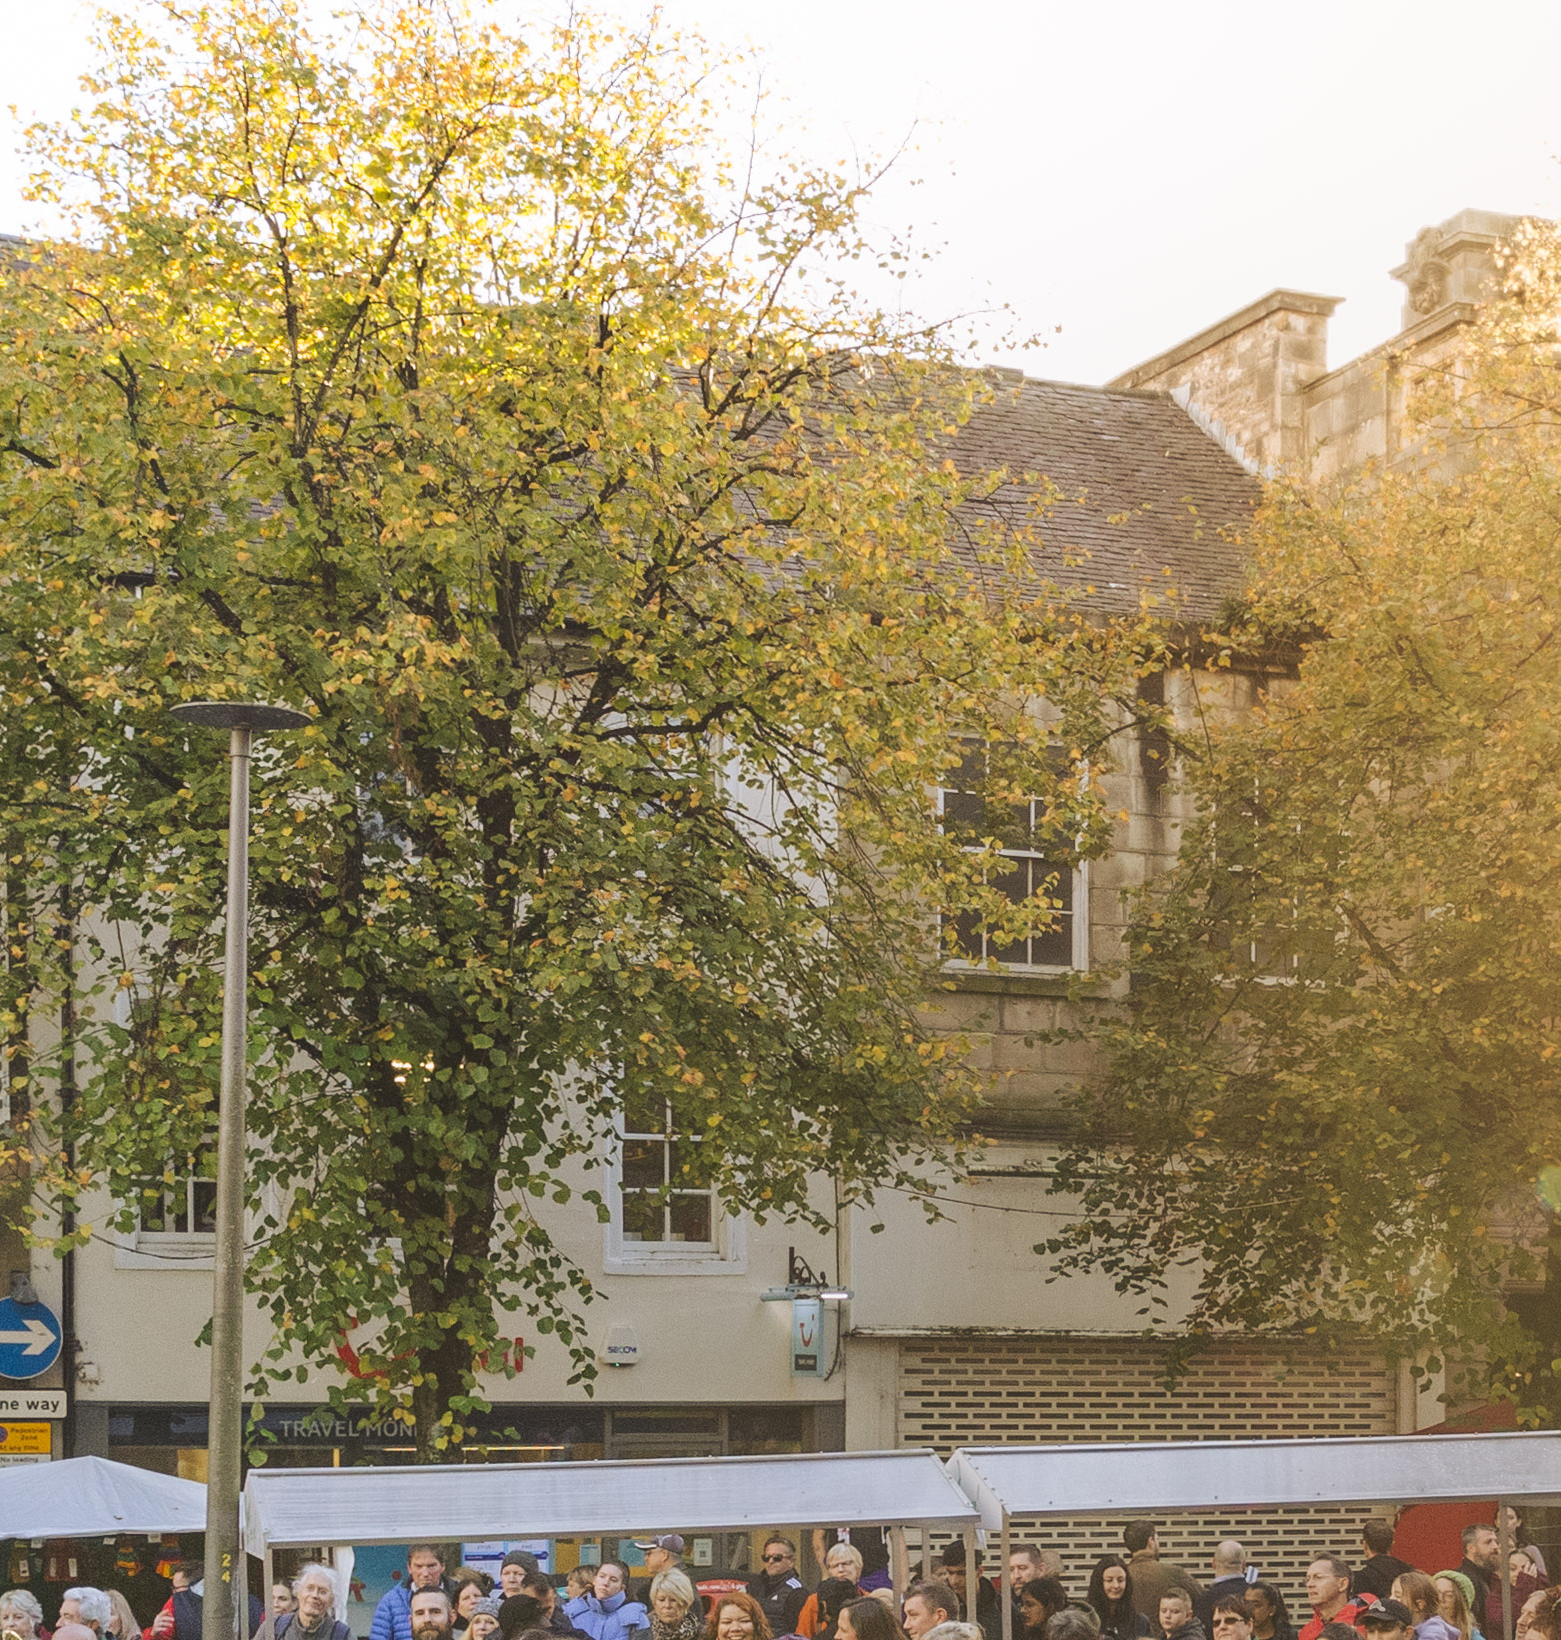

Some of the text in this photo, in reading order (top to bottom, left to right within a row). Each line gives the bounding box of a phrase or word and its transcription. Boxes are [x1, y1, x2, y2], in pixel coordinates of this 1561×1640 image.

[26, 1400, 60, 1413] way
[280, 1420, 417, 1438] TRAVEL MON
